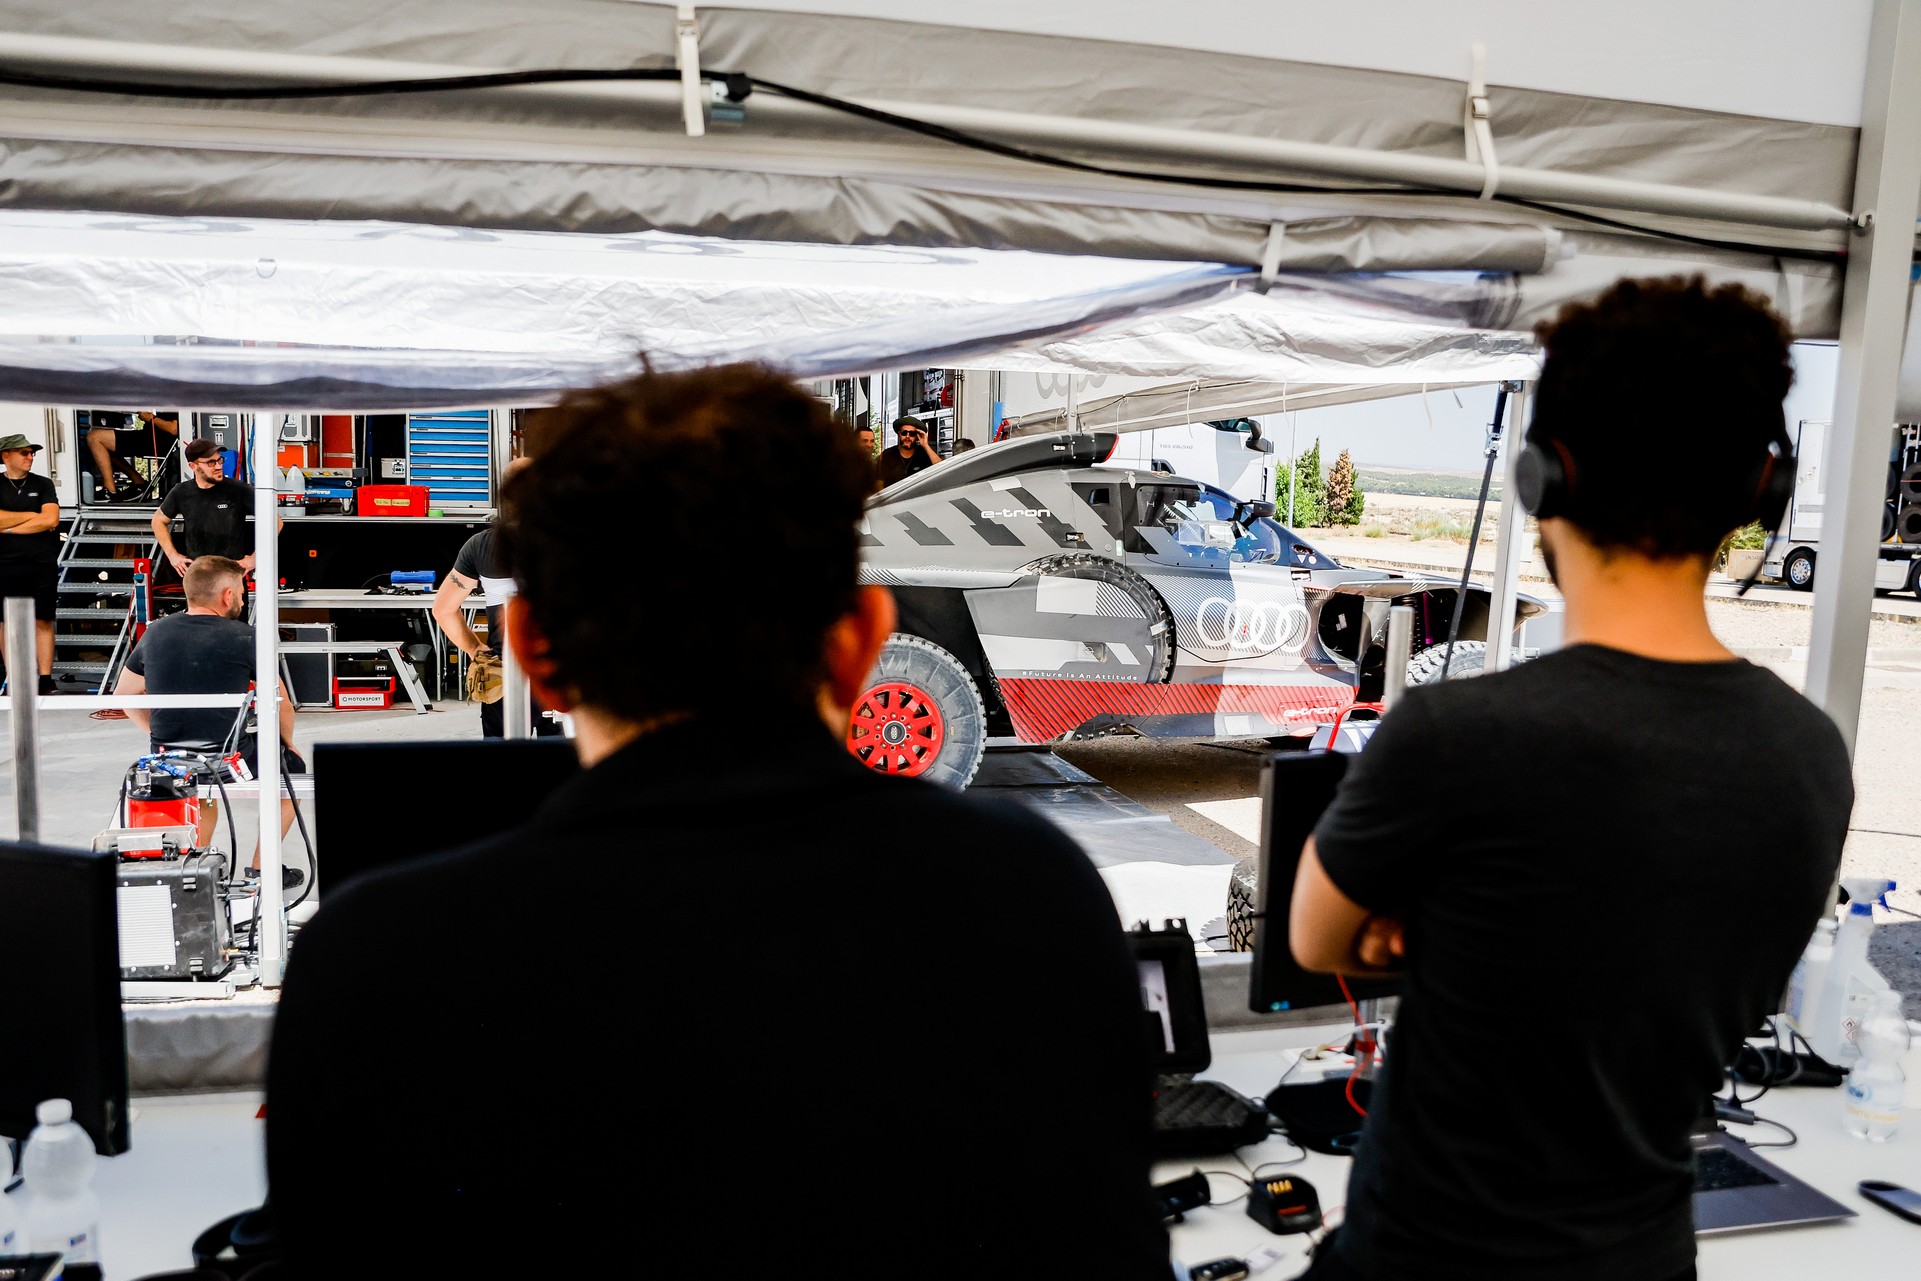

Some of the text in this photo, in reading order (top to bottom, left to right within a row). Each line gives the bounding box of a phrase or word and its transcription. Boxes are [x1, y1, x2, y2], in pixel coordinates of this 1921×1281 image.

[980, 508, 1051, 519] e-tron
[1095, 673, 1138, 681] Attitude
[1283, 706, 1338, 717] e-tron
